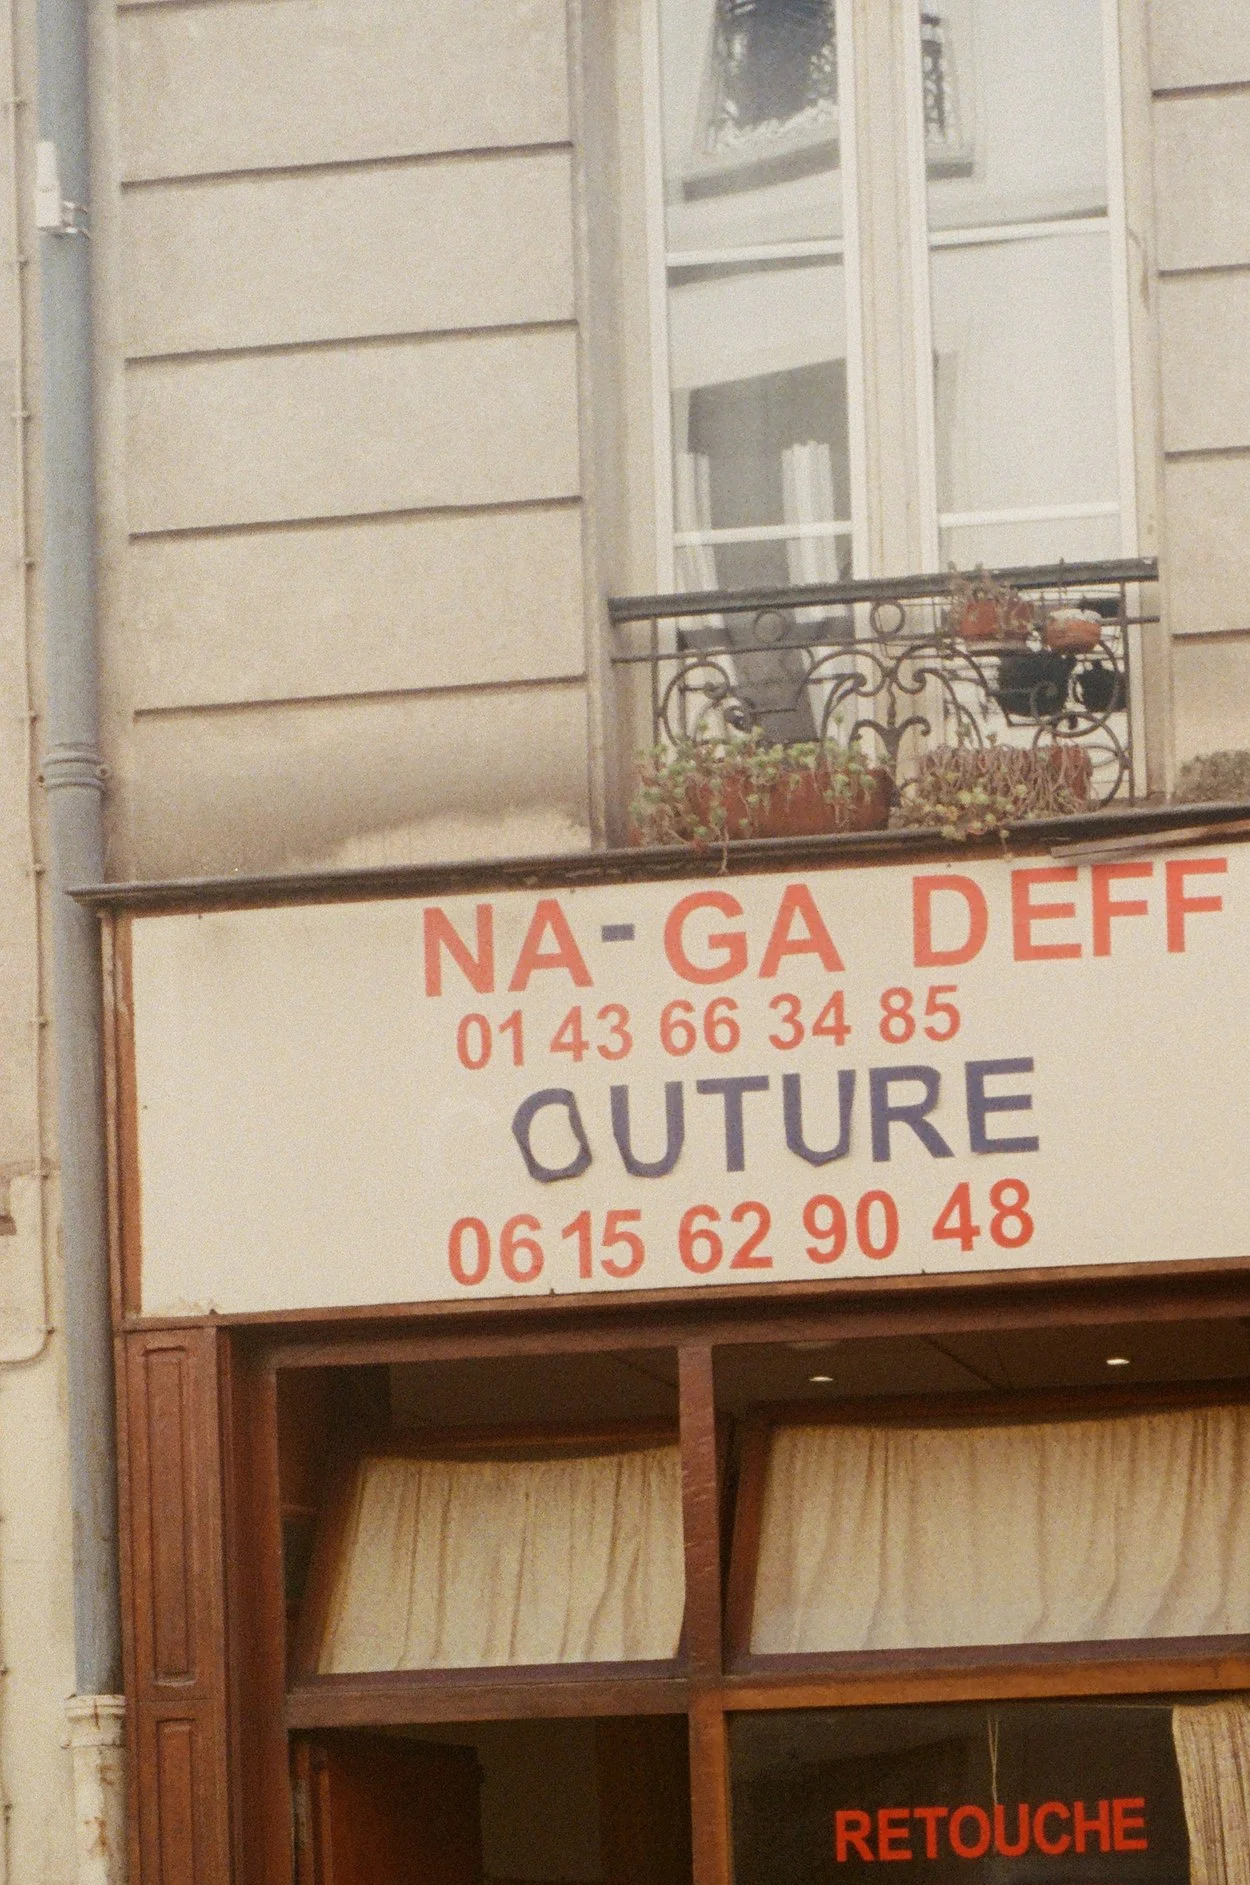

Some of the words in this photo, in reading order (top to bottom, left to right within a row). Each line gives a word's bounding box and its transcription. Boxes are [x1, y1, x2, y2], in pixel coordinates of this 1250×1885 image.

[423, 883, 845, 997] NA-GA
[912, 857, 1229, 968] DEFF
[456, 1011, 525, 1070] 01
[549, 1003, 634, 1061] 43
[660, 996, 741, 1057] 66
[769, 990, 853, 1051] 34
[879, 984, 962, 1045] 85
[511, 1056, 1041, 1183] OUTURE
[677, 1200, 775, 1275] 62
[802, 1189, 900, 1265] 90
[931, 1177, 1036, 1253] 48
[834, 1797, 1149, 1863] RETOUCHE
